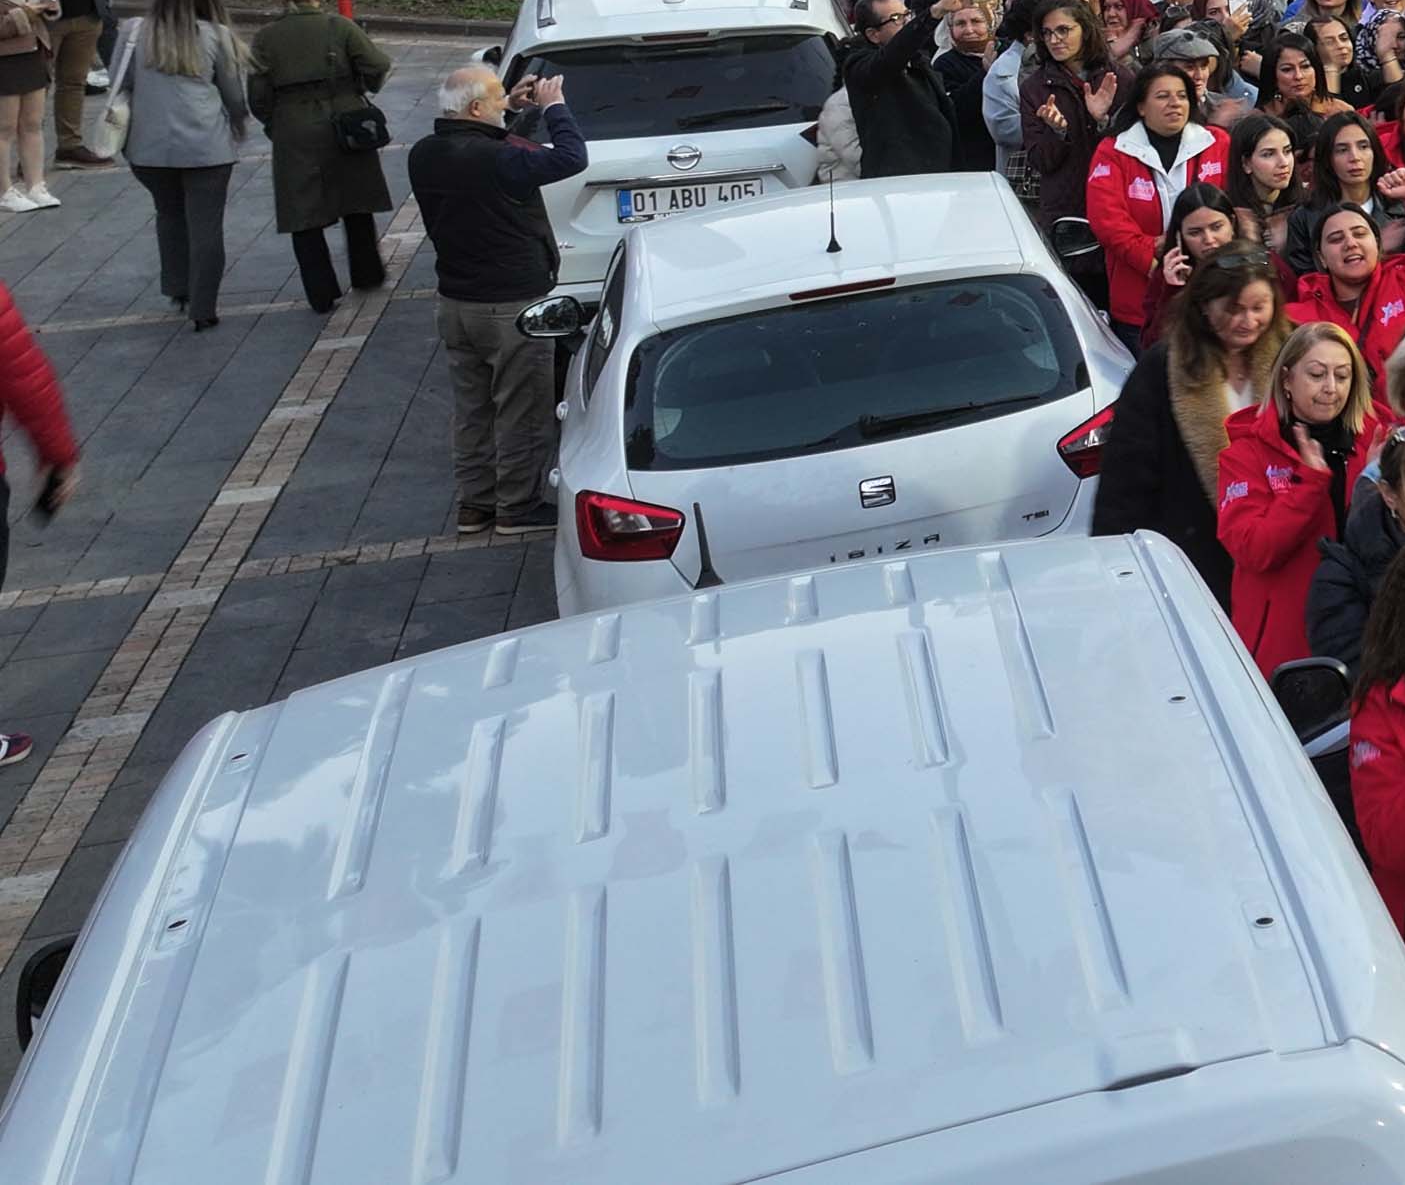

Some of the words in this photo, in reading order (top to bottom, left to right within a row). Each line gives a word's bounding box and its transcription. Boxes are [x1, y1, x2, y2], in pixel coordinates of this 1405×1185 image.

[633, 191, 657, 213] 01
[669, 187, 707, 209] ABU
[829, 533, 941, 563] IBIZA
